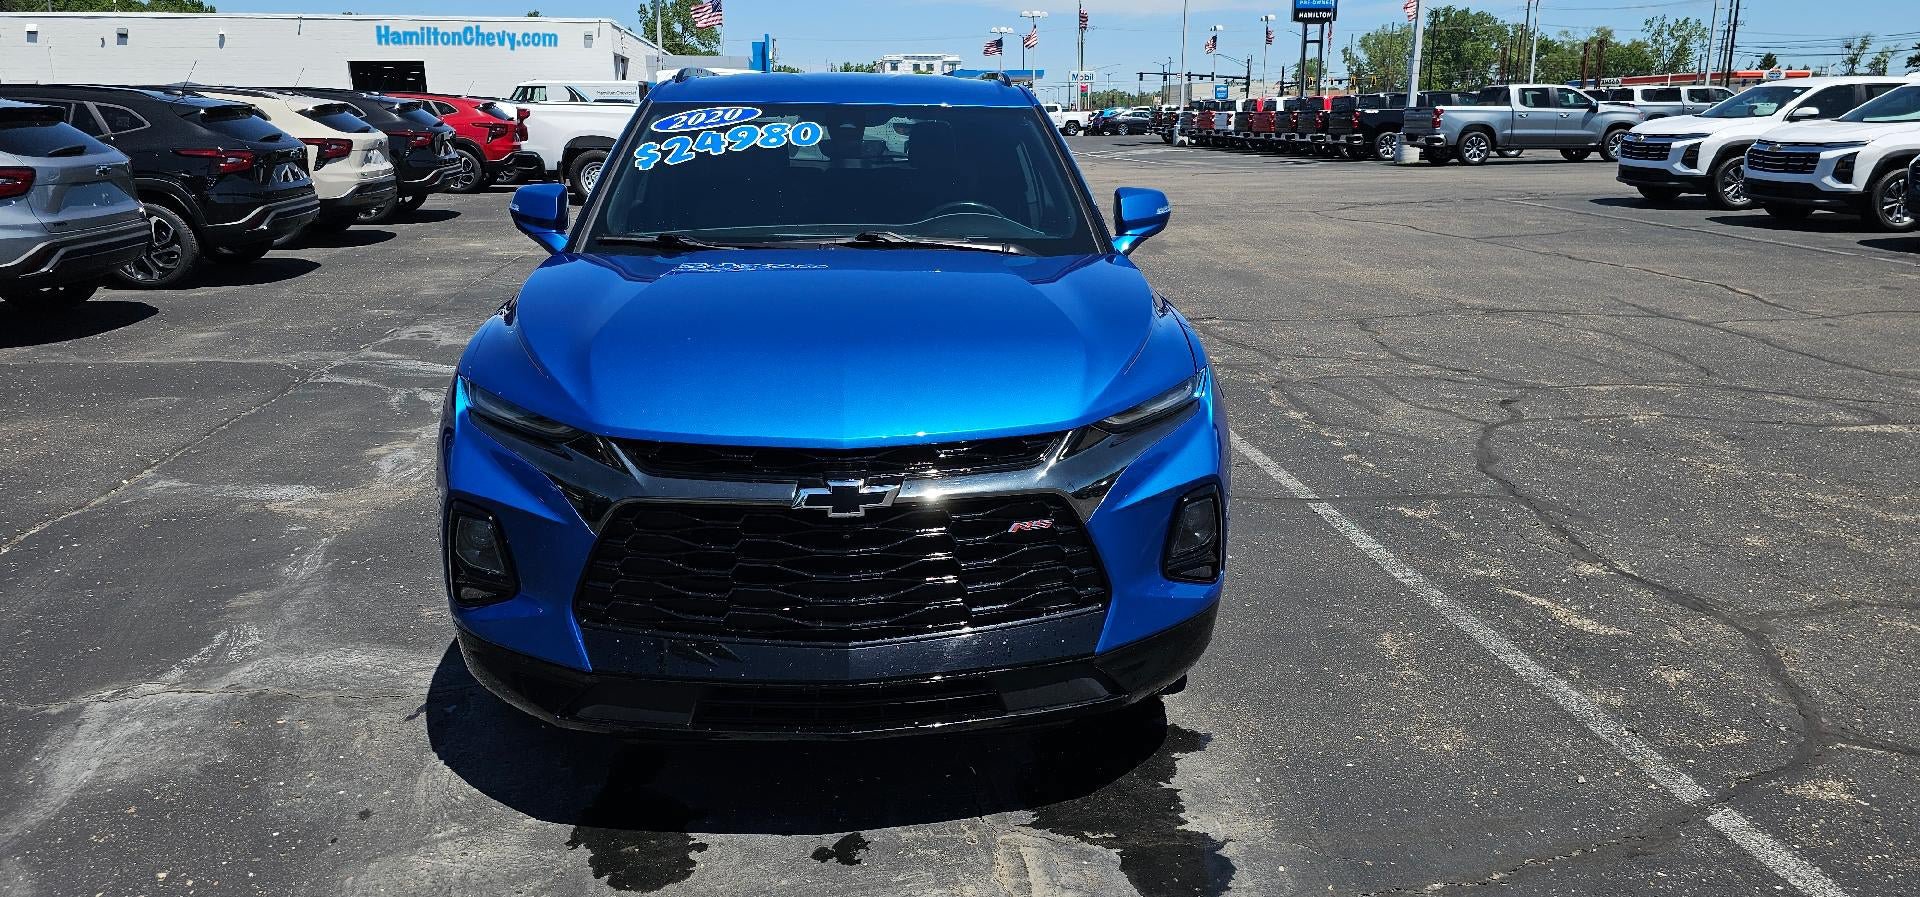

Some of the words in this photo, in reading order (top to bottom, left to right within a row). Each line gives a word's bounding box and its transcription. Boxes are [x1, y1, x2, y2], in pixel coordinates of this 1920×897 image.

[376, 25, 558, 50] HamiltonChevy.com
[1072, 73, 1094, 81] Mobil
[668, 109, 743, 130] 2020
[634, 122, 823, 171] $24980
[1008, 519, 1054, 533] RS
